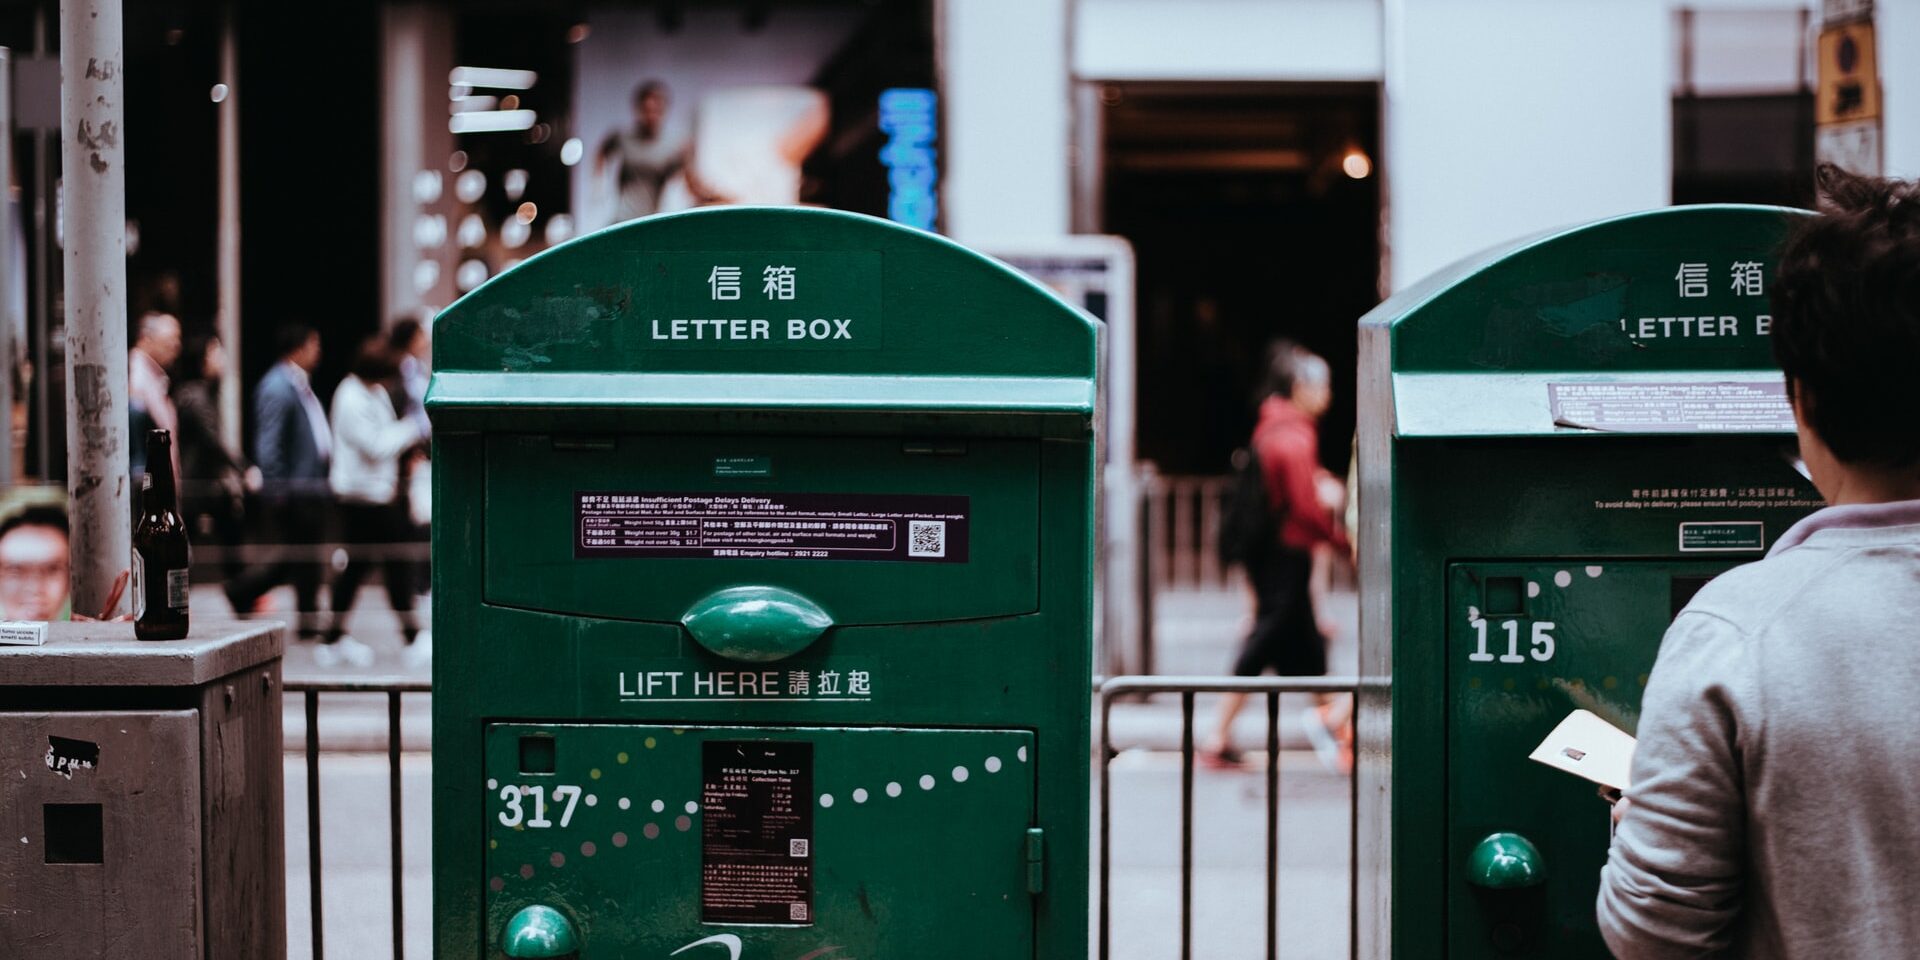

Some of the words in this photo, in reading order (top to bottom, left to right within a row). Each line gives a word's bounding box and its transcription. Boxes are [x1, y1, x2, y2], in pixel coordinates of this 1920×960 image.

[708, 265, 796, 300] 信箱
[1675, 261, 1763, 297] 信箱
[651, 319, 769, 340] LETTER
[787, 318, 852, 340] BOX
[683, 497, 713, 505] Postage
[741, 497, 771, 505] Delivery
[1624, 501, 1641, 509] delay
[1469, 618, 1555, 662] 115
[619, 672, 683, 696] LIFT
[694, 672, 780, 696] HERE
[788, 670, 872, 696] 請拉起
[499, 784, 582, 828] 317
